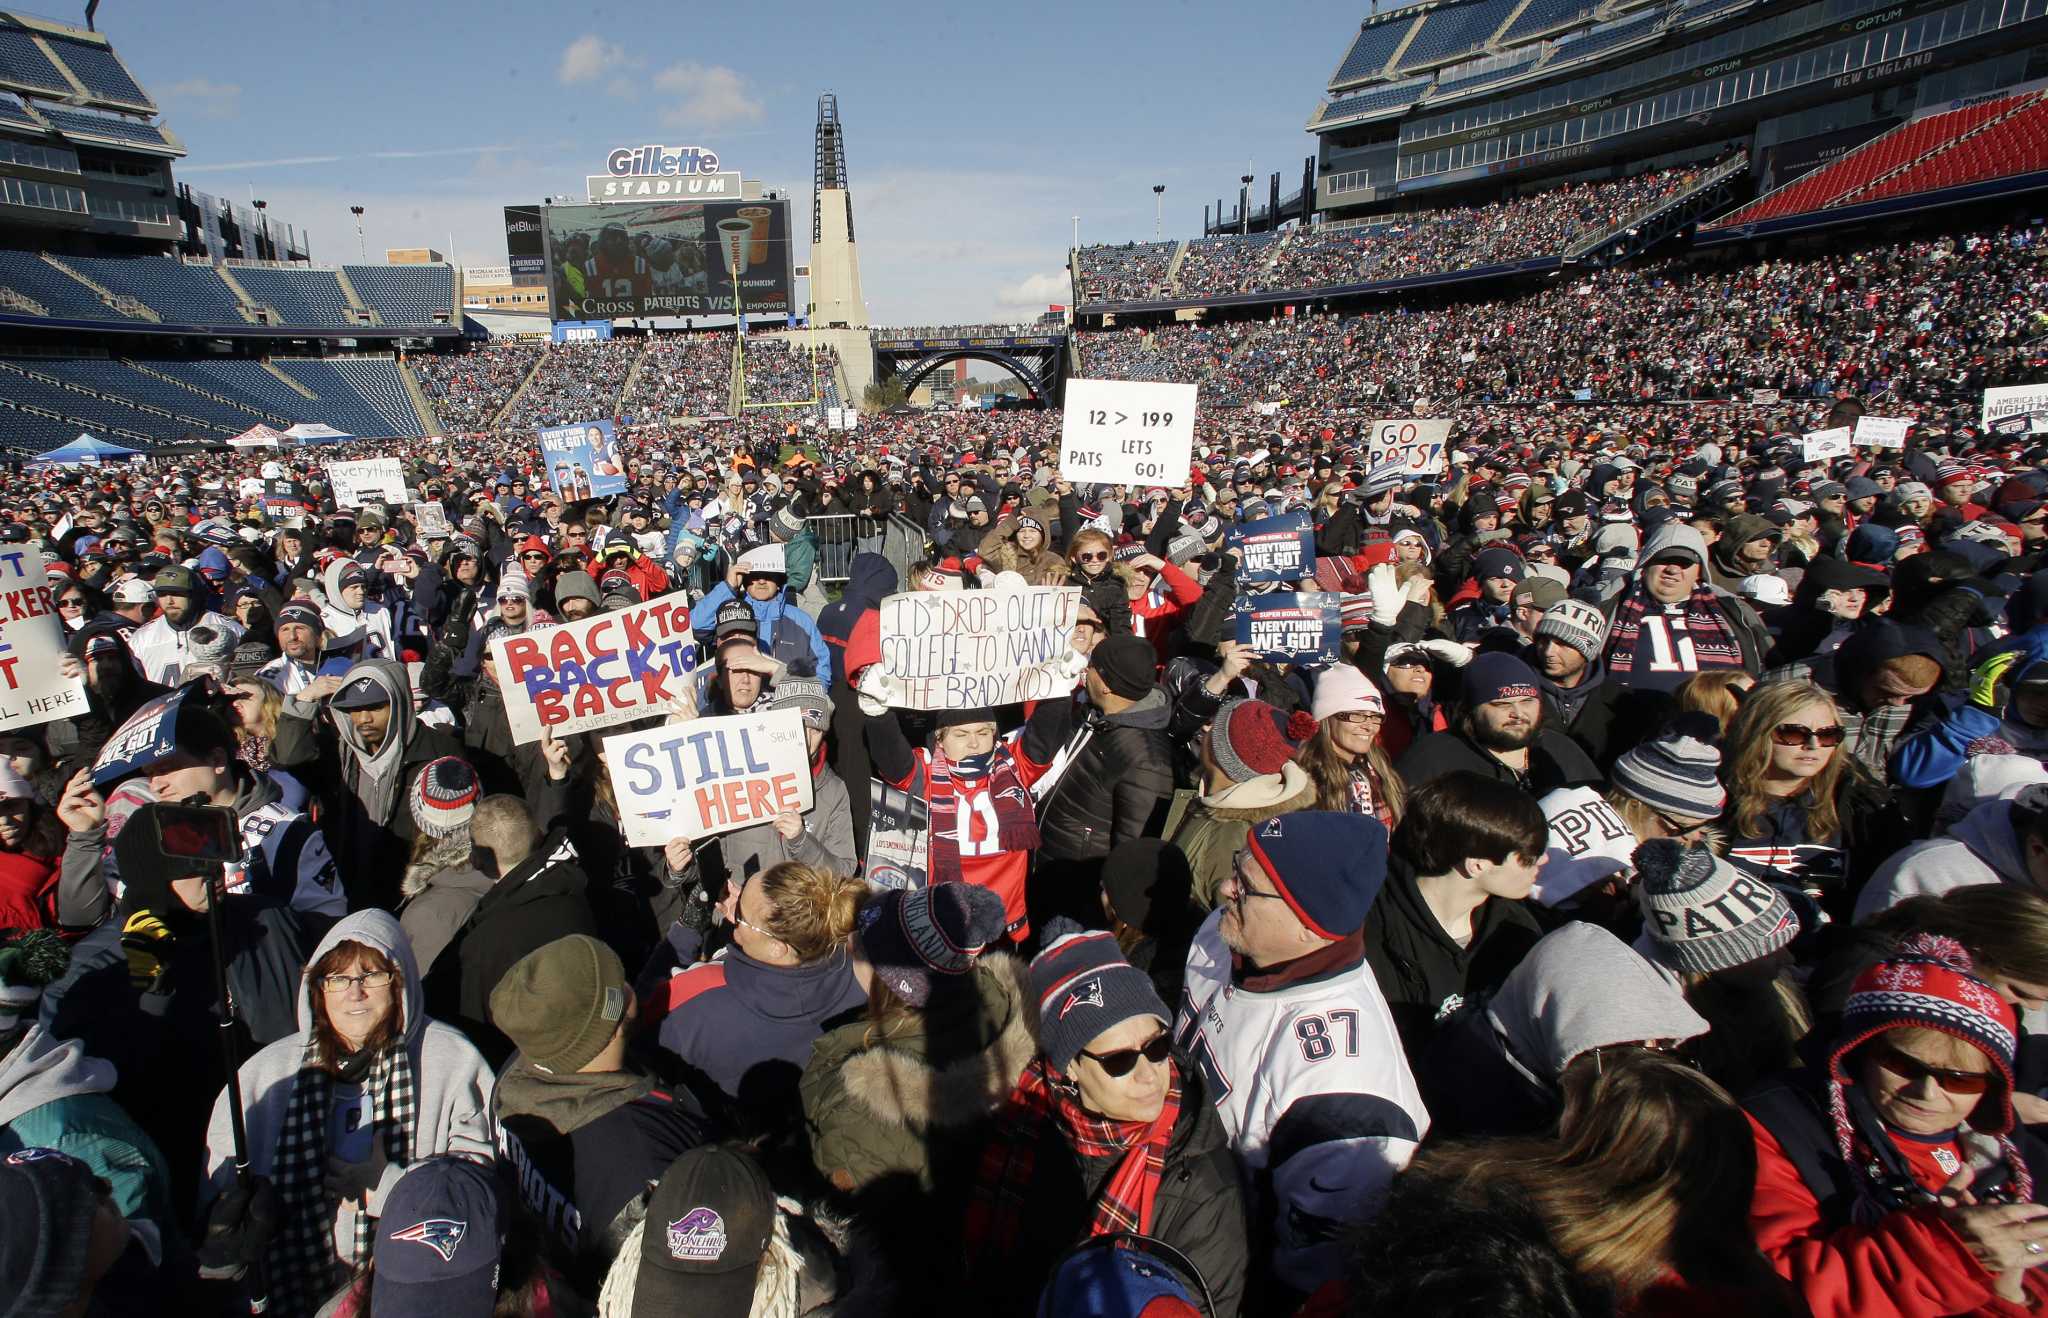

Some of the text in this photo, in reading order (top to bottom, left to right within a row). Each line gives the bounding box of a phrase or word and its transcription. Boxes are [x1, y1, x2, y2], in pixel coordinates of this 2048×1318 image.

[1855, 8, 1904, 31] OPTUM
[1704, 58, 1742, 77] OPTUM
[1833, 52, 1934, 89] NEW ENGLAND
[1580, 98, 1612, 113] OPTUM
[1470, 127, 1500, 139] OPTUM
[607, 146, 719, 176] Gillette
[604, 178, 725, 197] STADIUM
[506, 221, 542, 235] jetBlue
[644, 296, 700, 311] PATRIOTS
[746, 302, 787, 310] EMPOWER
[566, 329, 597, 341] BUD
[1089, 410, 1173, 427] 12 > 199
[541, 427, 586, 440] EVERYTHING
[1381, 424, 1417, 445] GO
[544, 440, 565, 452] WE
[1121, 440, 1153, 455] LETS
[1069, 450, 1103, 467] PATS
[1370, 444, 1441, 472] PATS!
[331, 464, 402, 479] Everything
[1135, 462, 1164, 480] GO!
[333, 479, 347, 488] We
[335, 487, 354, 499] Got
[267, 506, 283, 516] WE
[1244, 541, 1301, 554] EVERYTHING
[1245, 550, 1301, 569] WE GOT
[892, 591, 1081, 638] I'D DROP OUT OF
[1250, 620, 1323, 633] EVERYTHING
[504, 601, 690, 683] BACK TO
[1251, 632, 1324, 650] WE GOT
[881, 625, 1074, 679] COLLEGE TO NANNY
[525, 639, 697, 703] BACK TO
[535, 663, 674, 726] BACK
[899, 665, 1053, 709] THE BRADY KIDS
[27, 689, 82, 715] HERE.
[576, 713, 618, 730] SUPER
[624, 705, 654, 720] BOWL
[624, 727, 769, 796] STILL
[694, 773, 801, 830] HERE
[1293, 1008, 1360, 1063] 87
